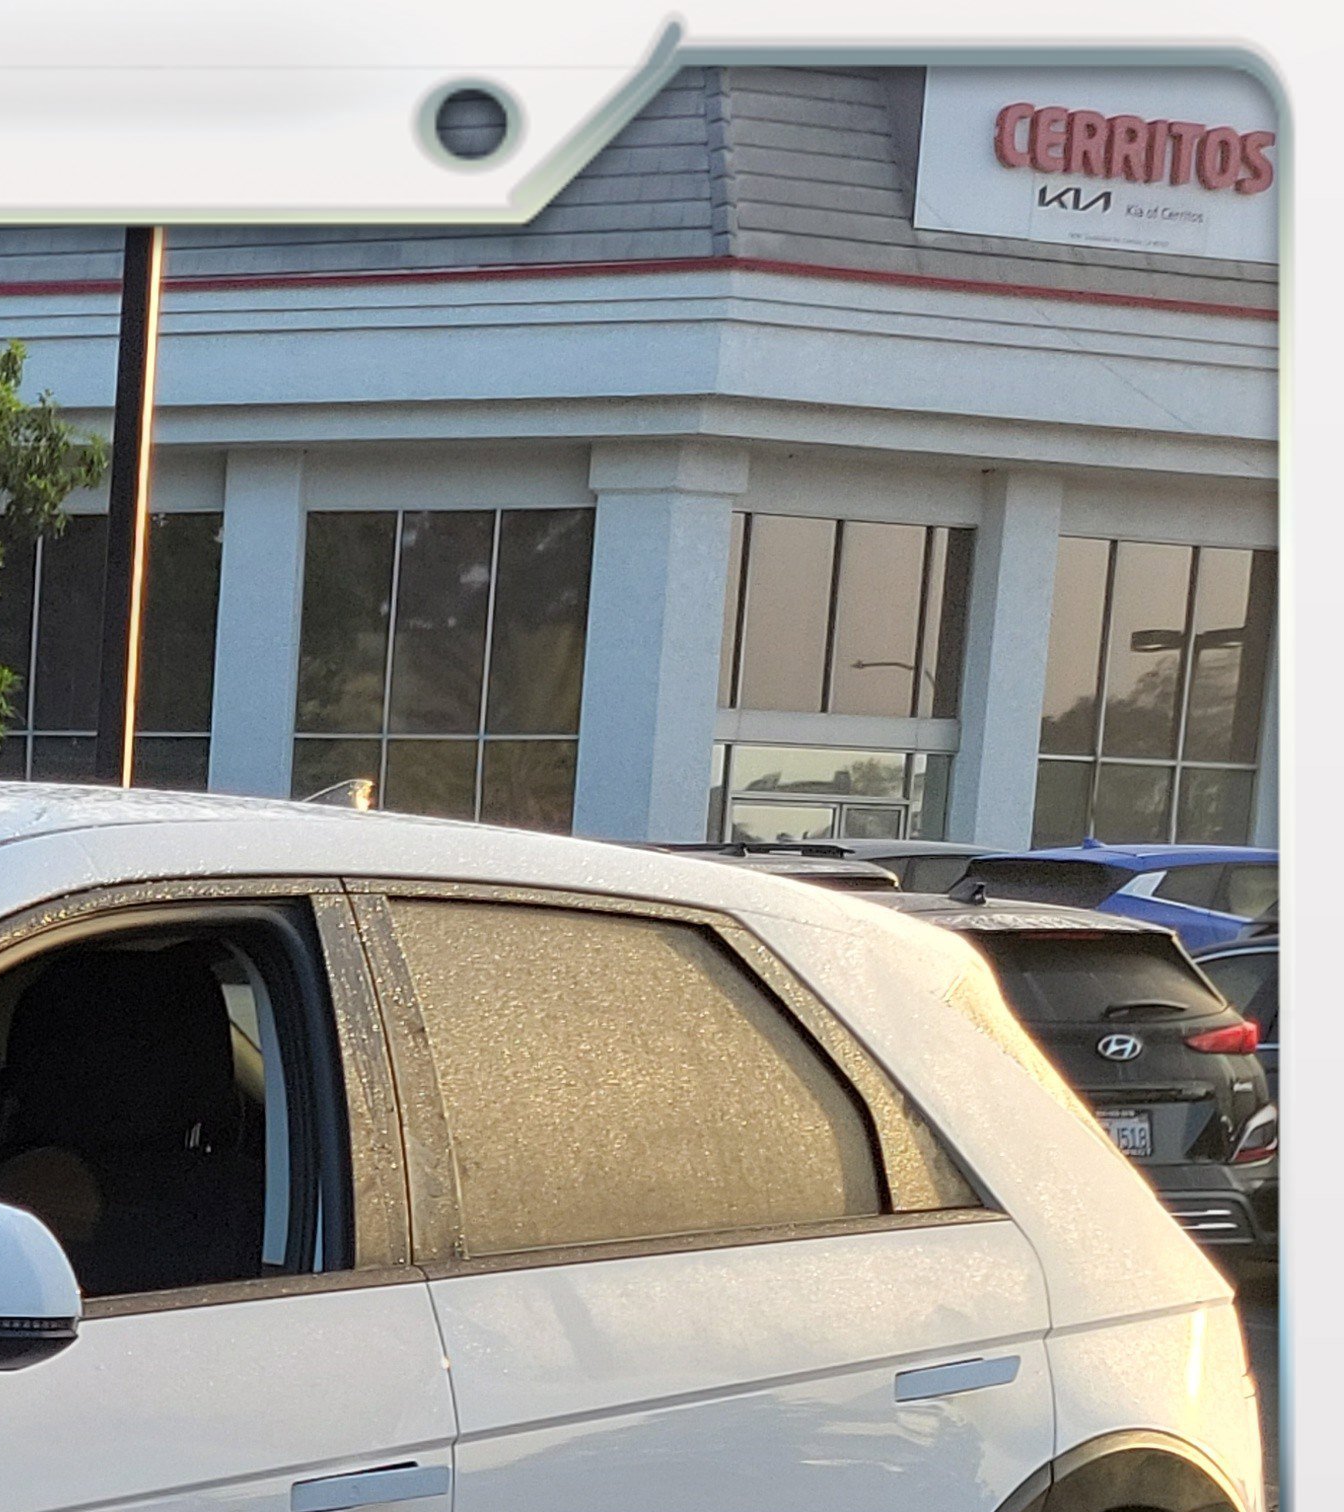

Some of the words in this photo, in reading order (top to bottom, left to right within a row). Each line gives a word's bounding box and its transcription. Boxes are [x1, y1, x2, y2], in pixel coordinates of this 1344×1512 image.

[994, 102, 1276, 195] CERRITOS
[1125, 204, 1143, 219] Kia
[1146, 206, 1159, 220] of
